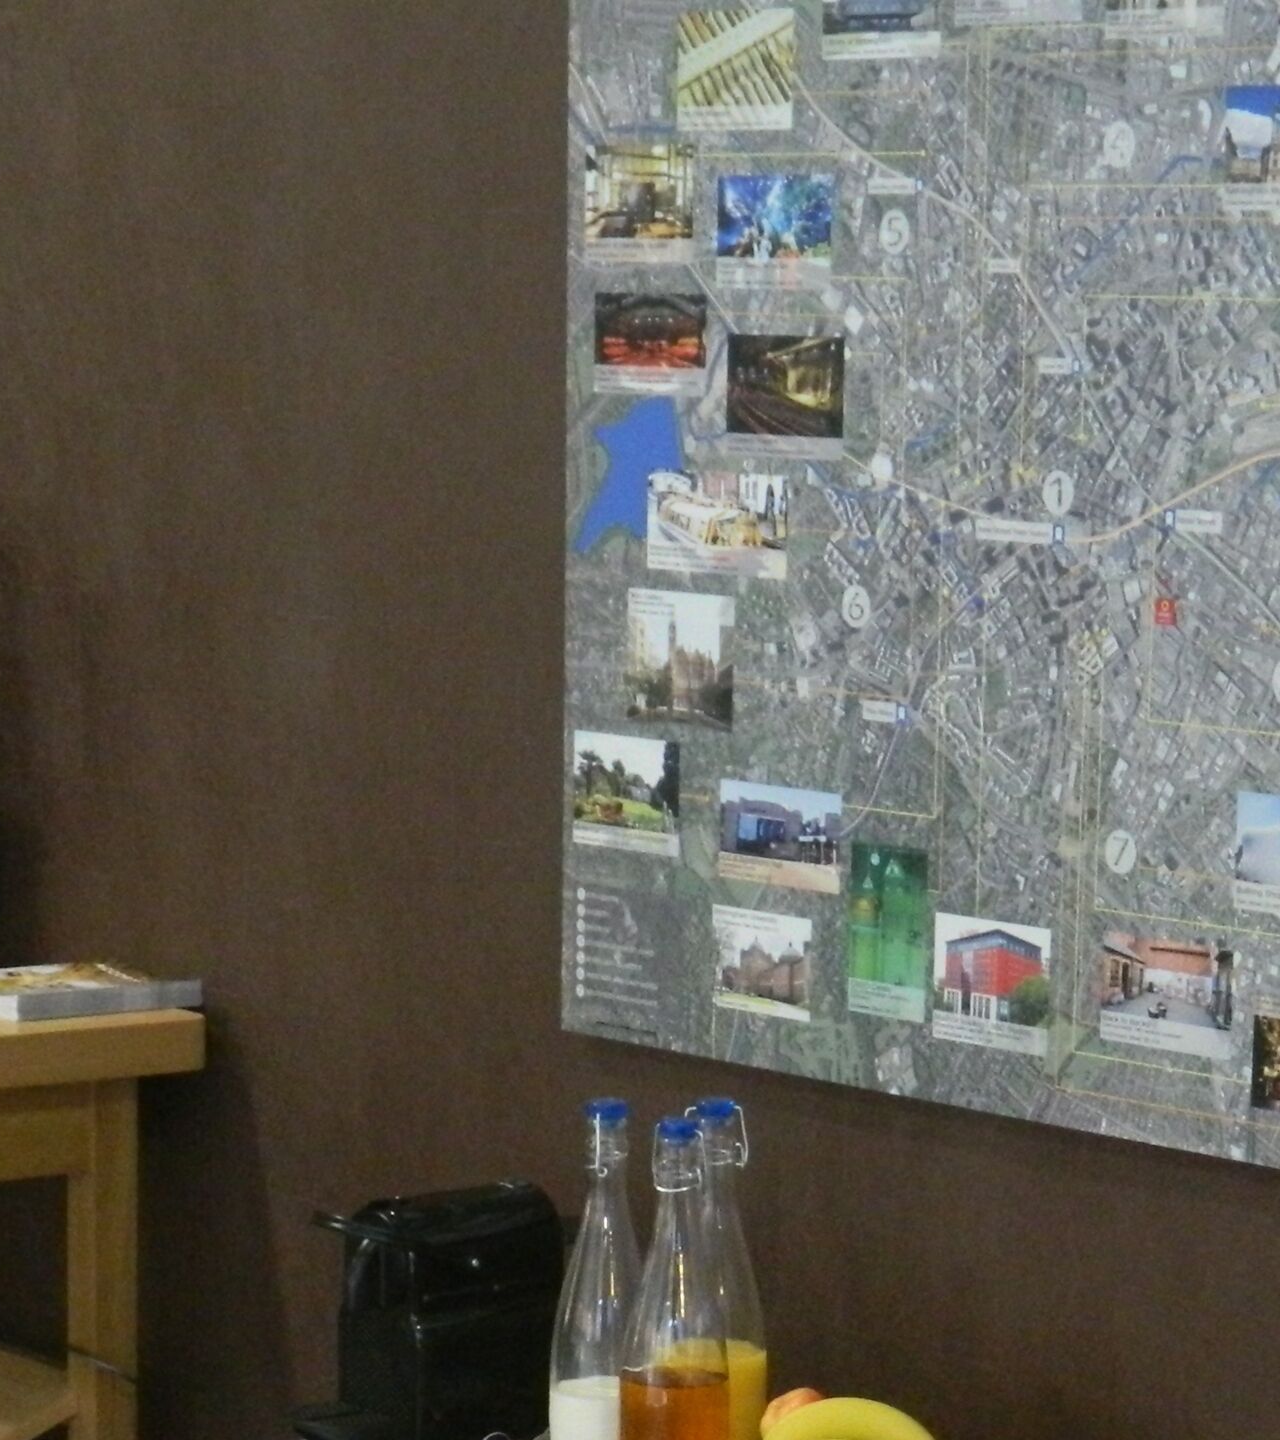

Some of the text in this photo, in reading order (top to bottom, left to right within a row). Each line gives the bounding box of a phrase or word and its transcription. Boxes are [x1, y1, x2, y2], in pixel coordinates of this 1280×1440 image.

[887, 216, 903, 247] 5
[1049, 478, 1064, 507] 1
[848, 591, 865, 622] 6
[1113, 836, 1129, 867] 7
